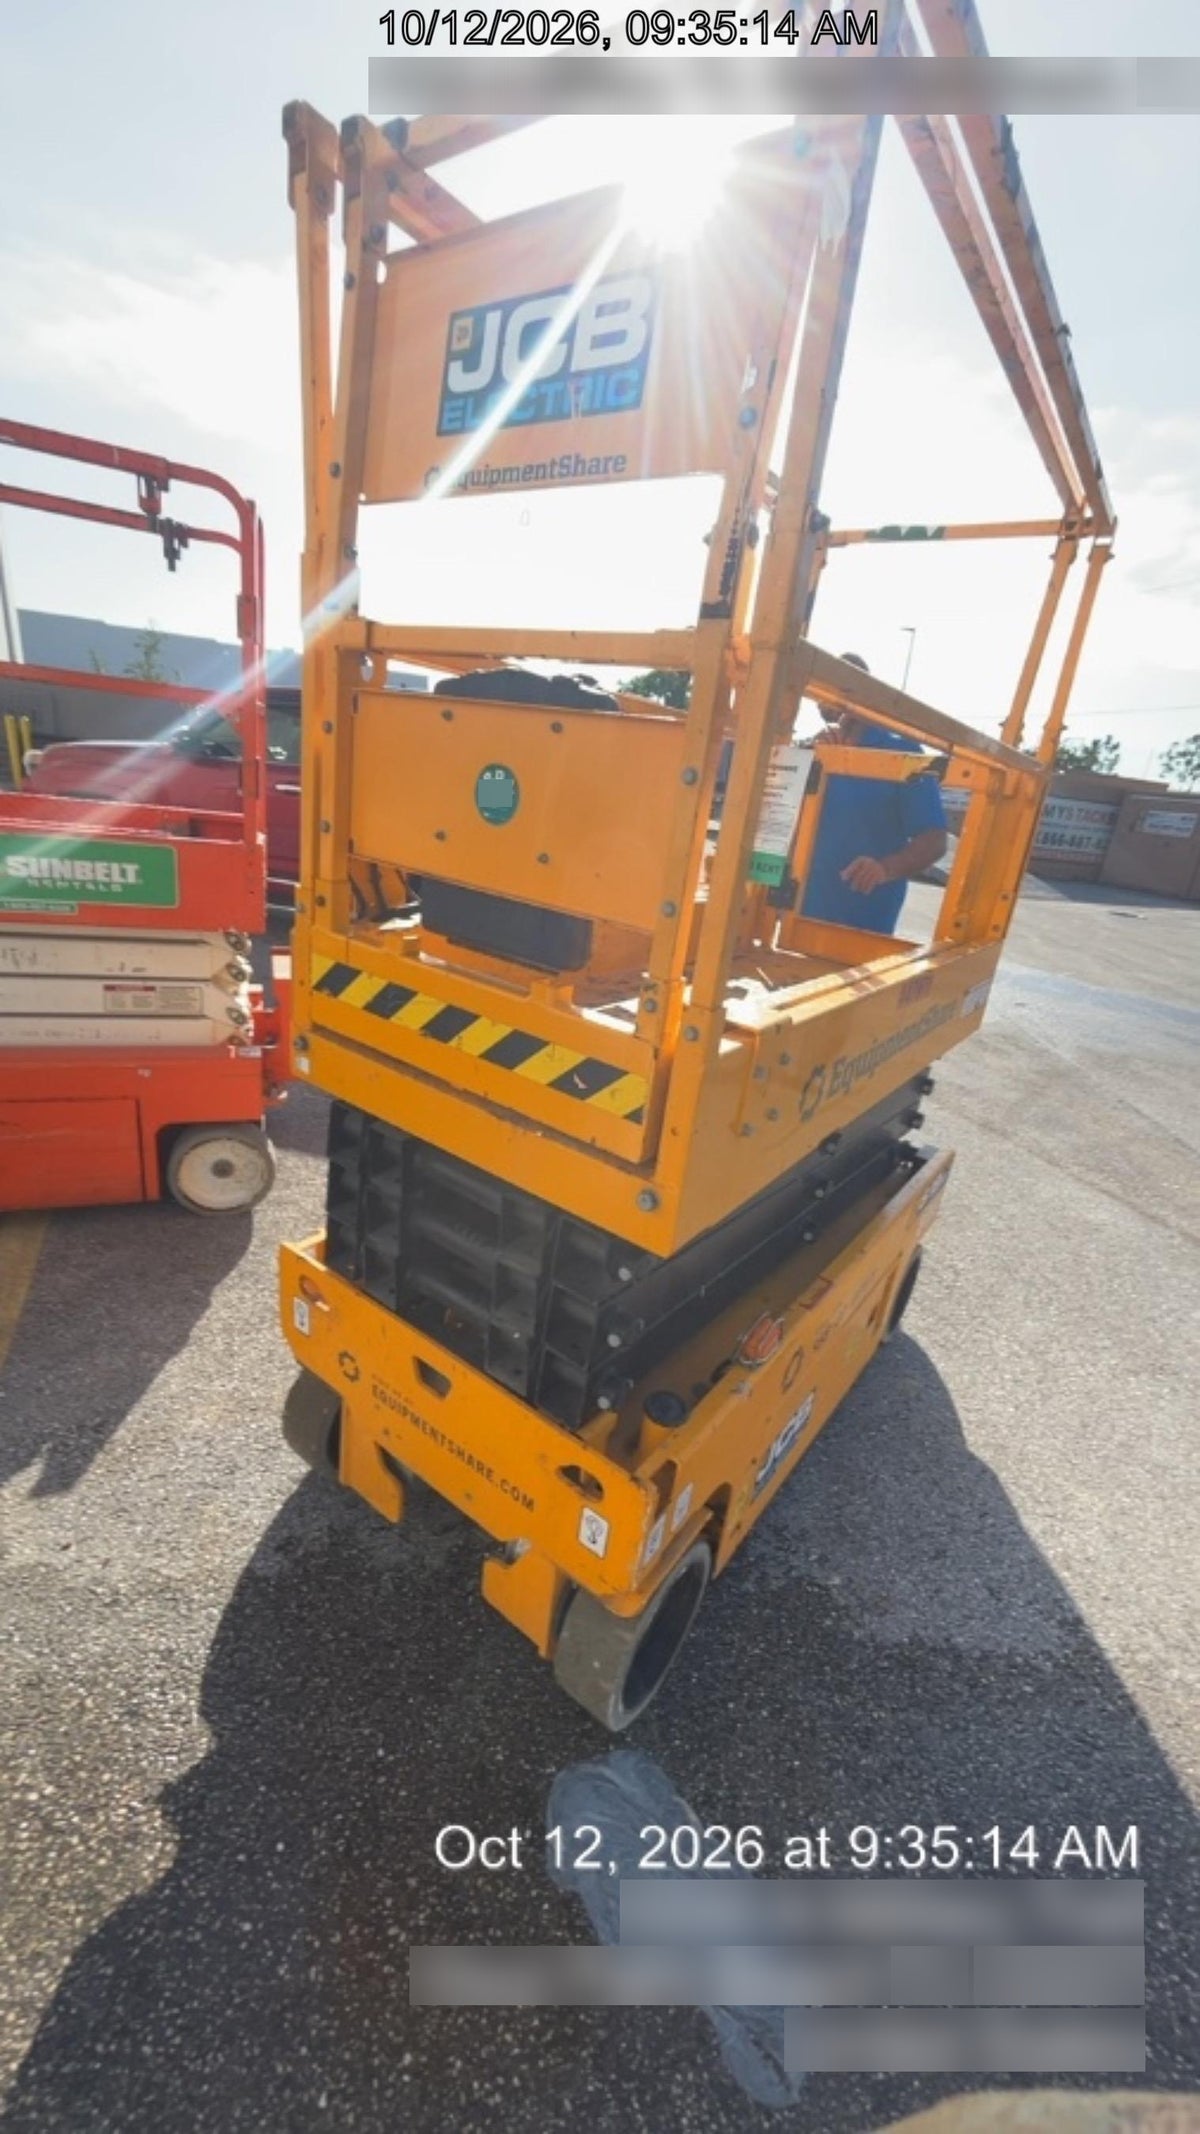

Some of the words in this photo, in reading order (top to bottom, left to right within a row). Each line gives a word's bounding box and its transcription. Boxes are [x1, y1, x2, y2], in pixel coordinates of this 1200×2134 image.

[447, 278, 652, 393] JCB
[5, 855, 140, 884] SUNBELT
[371, 1384, 535, 1512] EQUIPMENTSHARE.COM
